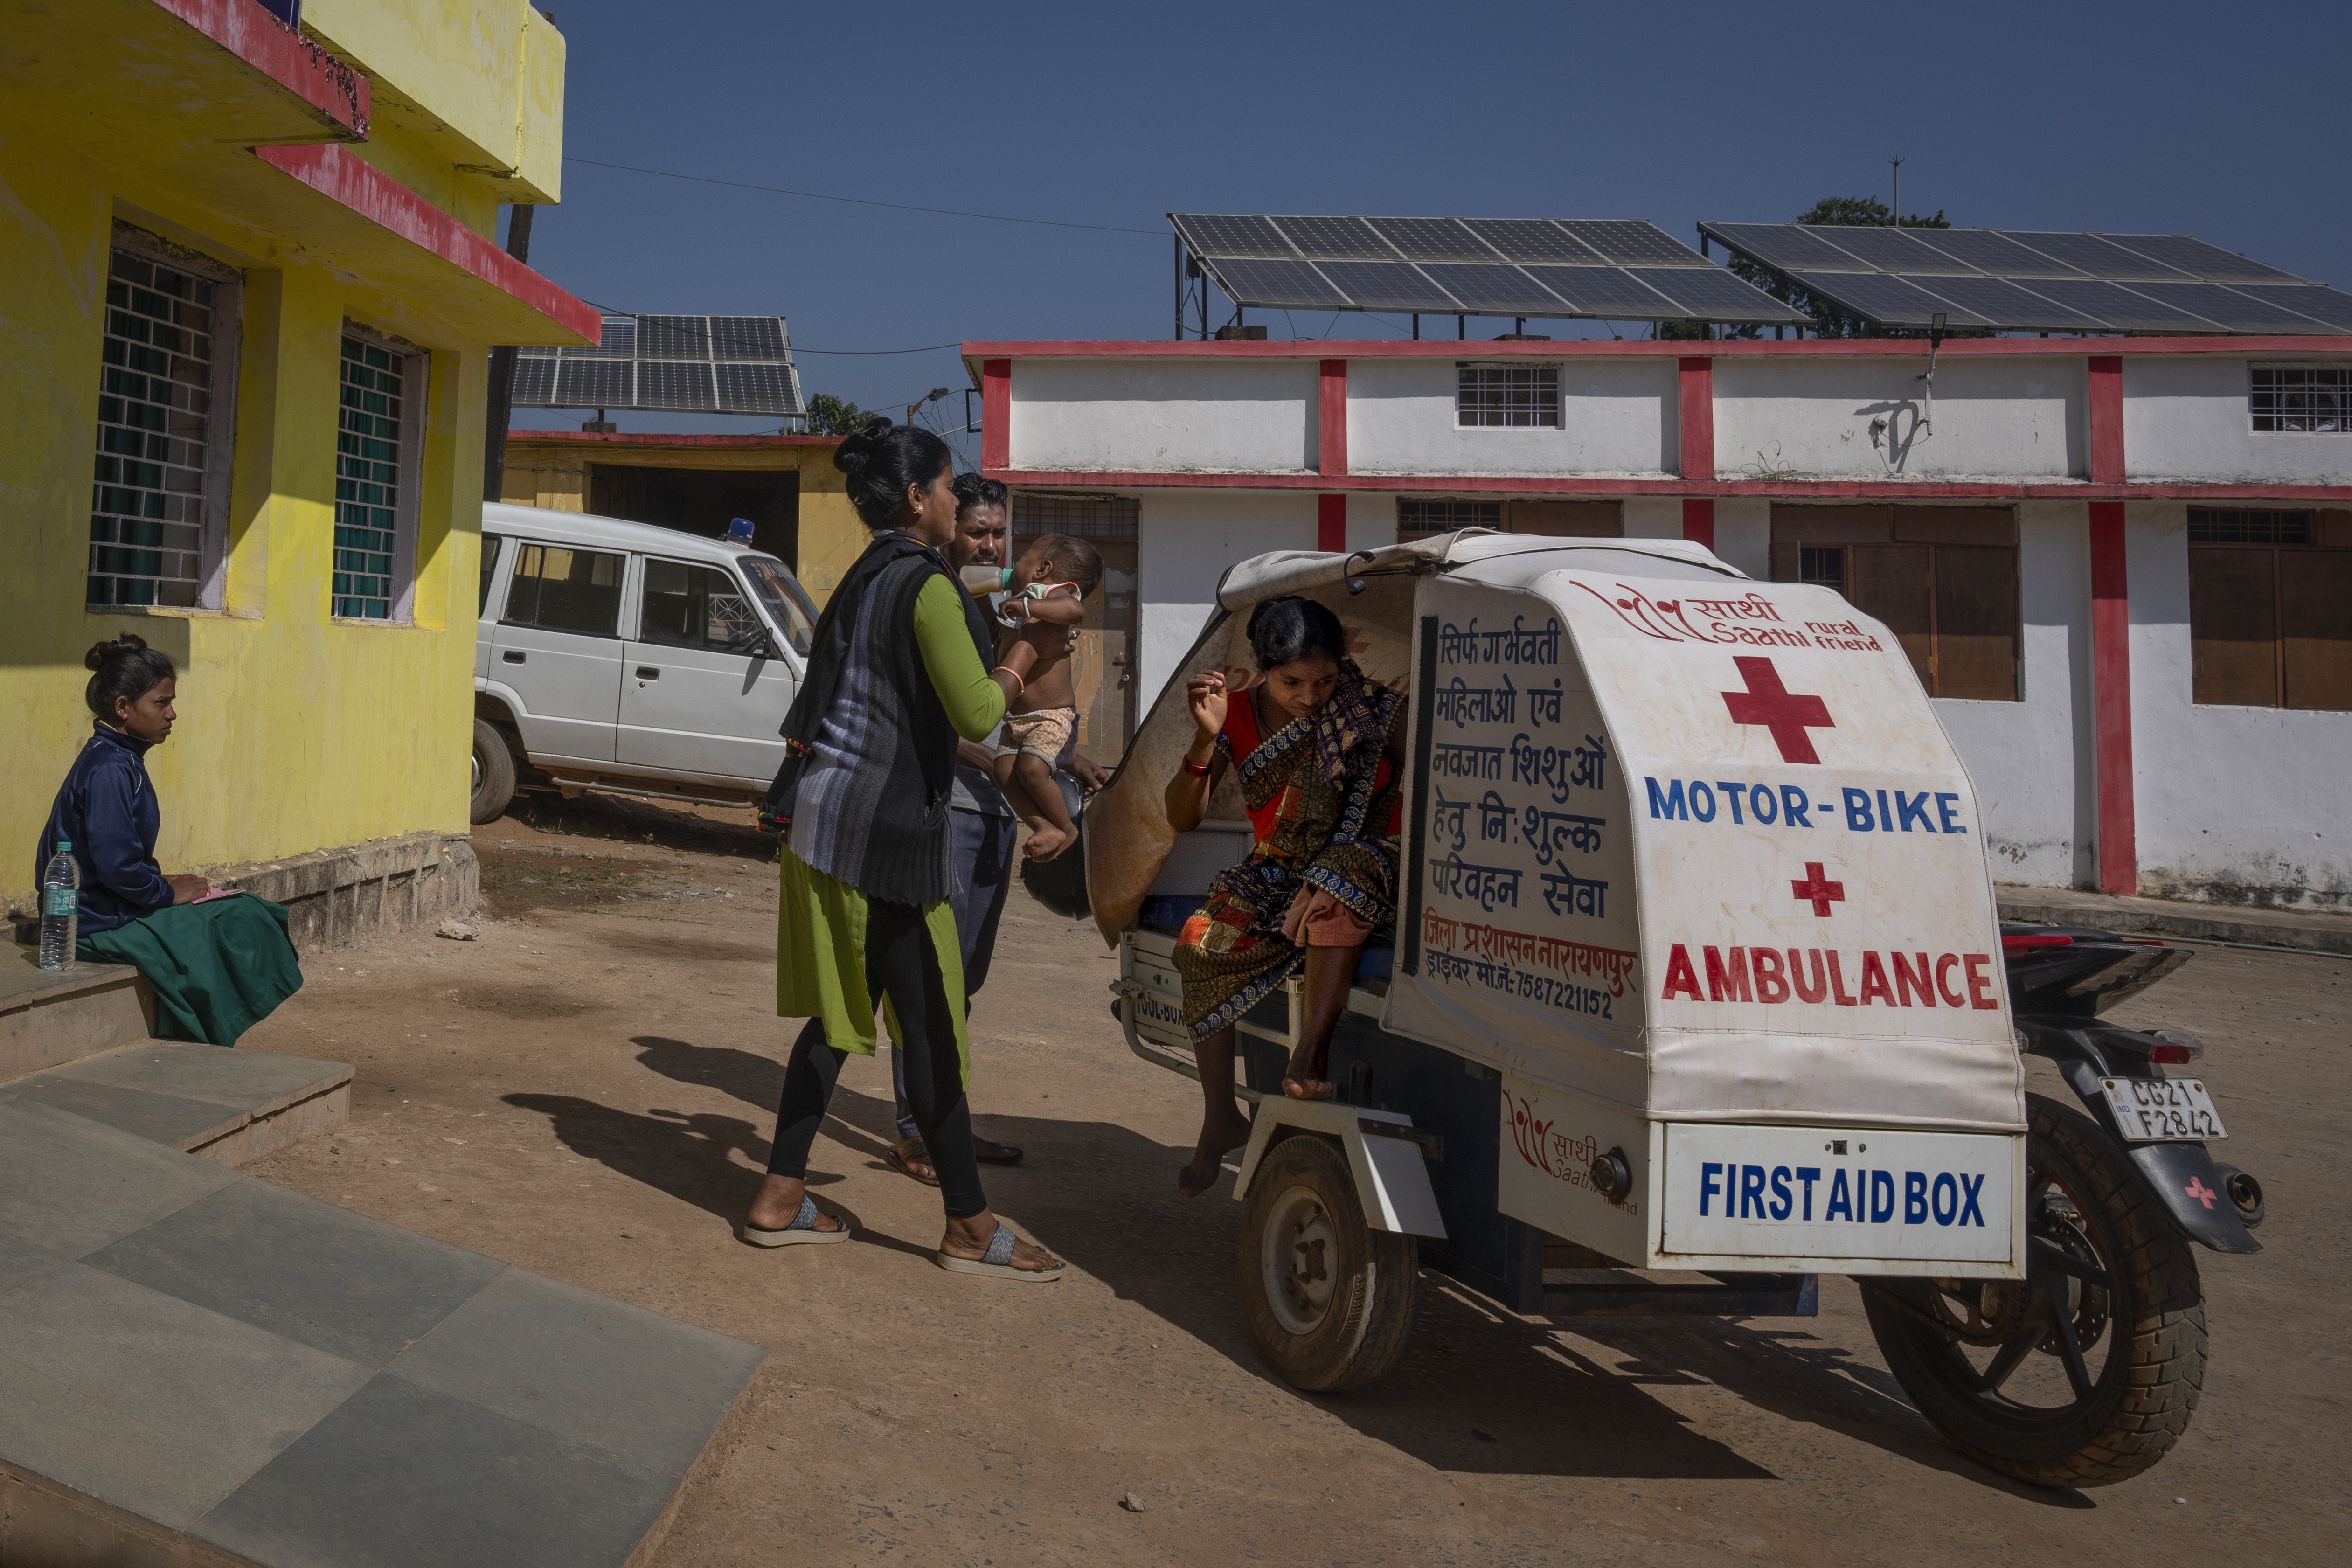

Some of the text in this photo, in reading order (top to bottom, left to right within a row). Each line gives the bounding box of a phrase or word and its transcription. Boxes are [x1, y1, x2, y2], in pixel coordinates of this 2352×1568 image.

[1685, 592, 1786, 622] साथी
[1804, 620, 1865, 636] rural
[1439, 617, 1479, 665] सिर्फ
[1814, 635, 1883, 652] friend
[1527, 678, 1564, 728] एवं
[1432, 733, 1607, 804] नवजात शिशुओं
[1432, 784, 1471, 852] हेतु
[1429, 851, 1609, 919] परिवहन सेवा
[1422, 906, 1638, 998] जिला प्रशासन नारायणपुर
[1662, 943, 1998, 1010] AMBULANCE
[1515, 970, 1612, 1020] 7587221152
[2130, 1081, 2193, 1107] CG21
[2137, 1110, 2220, 1137] F2842
[1699, 1162, 1985, 1228] FIRST AID BOX
